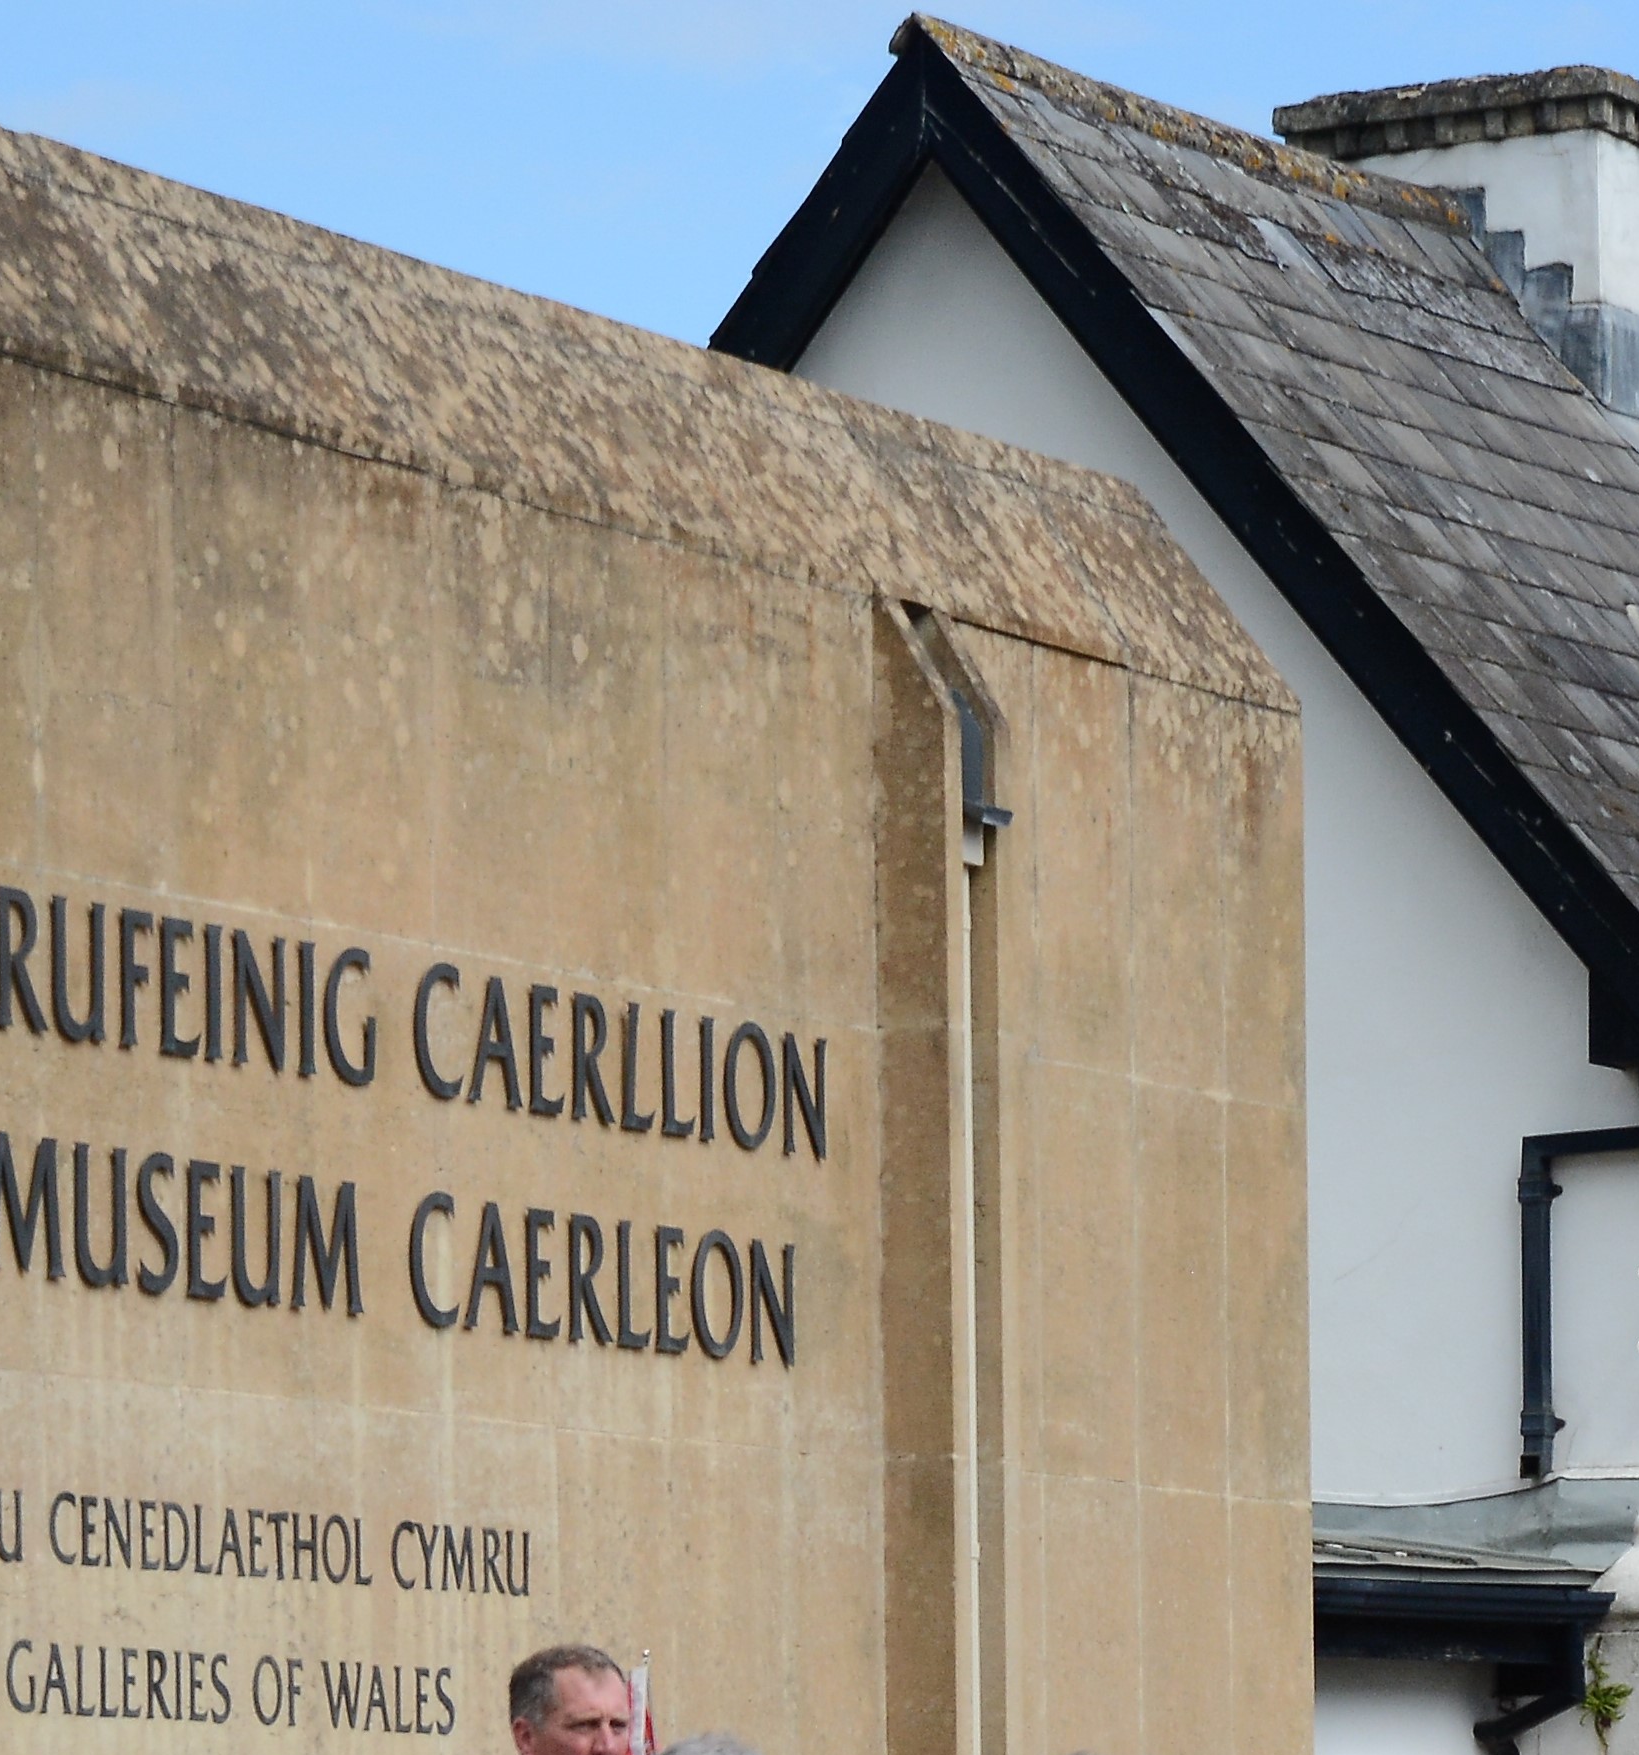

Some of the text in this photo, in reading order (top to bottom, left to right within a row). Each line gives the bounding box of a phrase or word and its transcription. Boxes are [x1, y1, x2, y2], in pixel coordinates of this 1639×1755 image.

[413, 962, 826, 1161] CAERLLION
[409, 1191, 796, 1369] CAERLEON
[49, 1490, 372, 1586] CENEDLAETHOL
[391, 1519, 531, 1597] CYMRU
[6, 1638, 231, 1724] GALLERIES
[253, 1654, 303, 1727] OF
[322, 1660, 455, 1736] WALES
